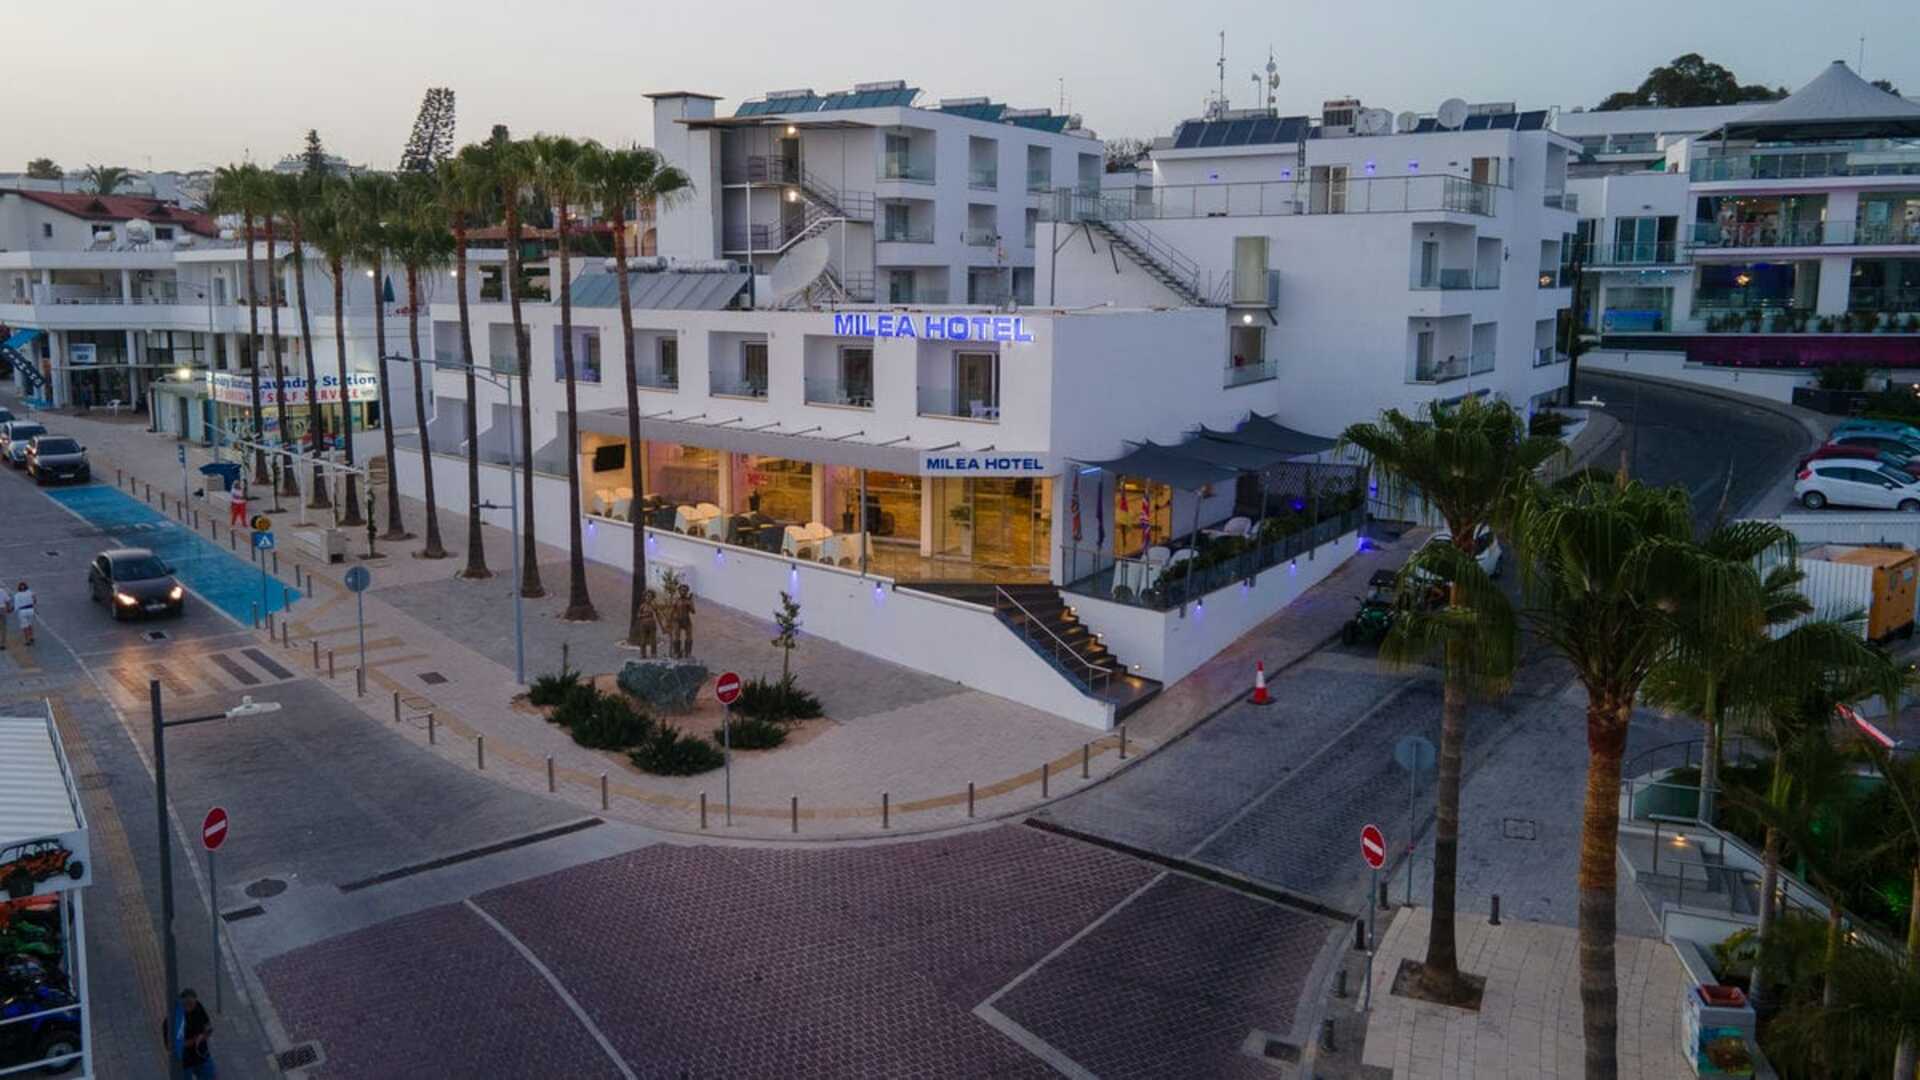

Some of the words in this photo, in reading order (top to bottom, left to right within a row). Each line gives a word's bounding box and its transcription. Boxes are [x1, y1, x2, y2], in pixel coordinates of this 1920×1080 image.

[834, 311, 917, 338] MILEA
[925, 315, 1034, 342] HOTEL
[322, 374, 377, 387] Sttion
[267, 390, 299, 402] SLF
[303, 388, 360, 401] SRVE
[926, 458, 979, 470] MILEA
[985, 458, 1044, 470] HOTEL
